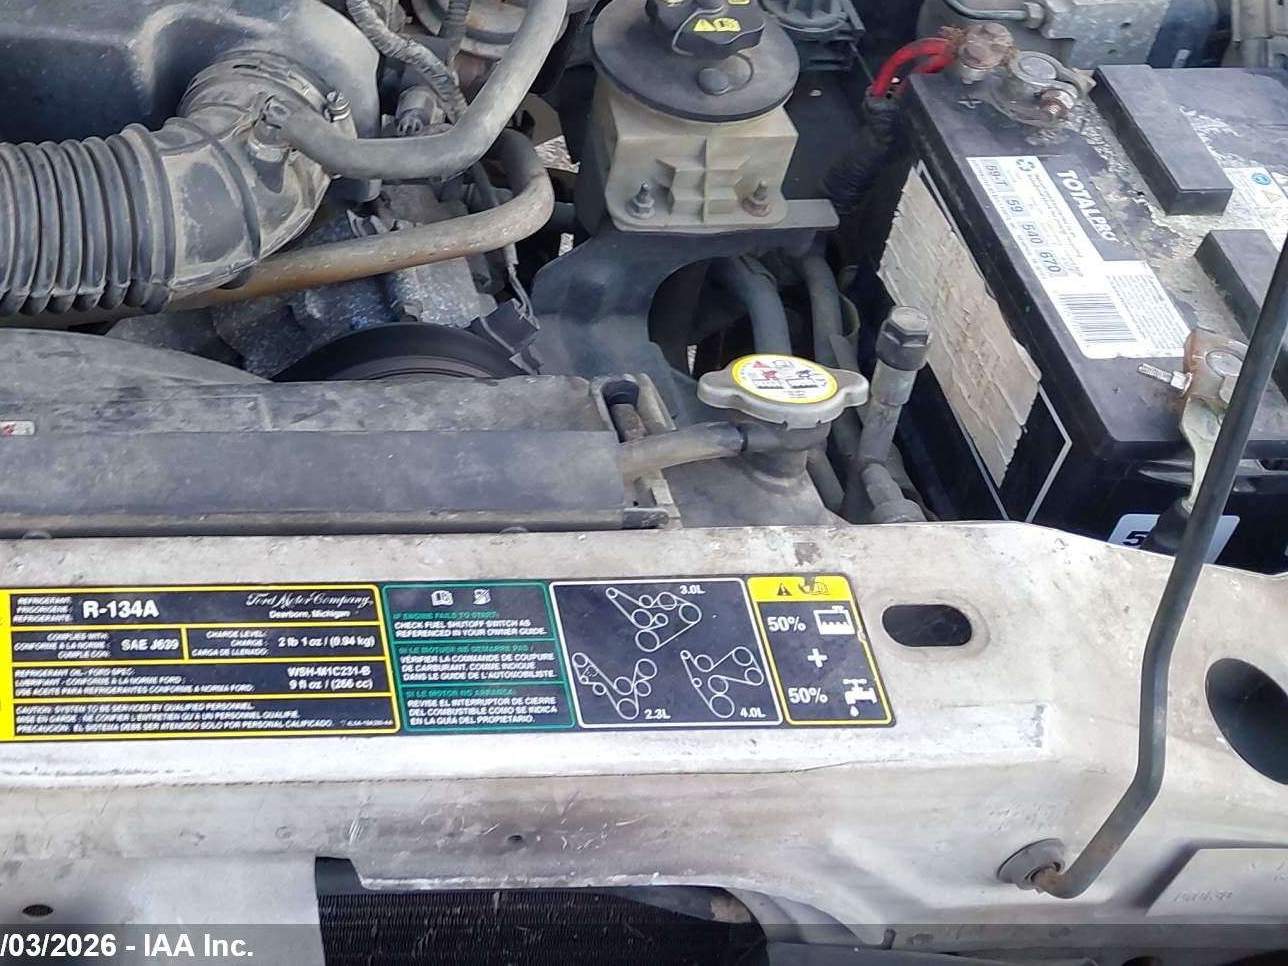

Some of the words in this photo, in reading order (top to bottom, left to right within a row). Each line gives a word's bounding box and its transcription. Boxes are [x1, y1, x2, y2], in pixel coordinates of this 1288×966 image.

[984, 164, 1009, 186] 59-T
[1008, 198, 1024, 213] 59
[1056, 170, 1120, 243] TOTALPRO
[1039, 251, 1062, 273] 670
[679, 584, 705, 595] 3.0L
[245, 592, 275, 606] Ford
[275, 591, 311, 609] Motor
[83, 600, 160, 619] R-134A
[394, 621, 424, 630] CHECK
[424, 621, 446, 629] FUEL
[447, 620, 484, 629] SHUTOFF
[485, 619, 518, 628] SWITCH
[519, 619, 531, 627] AS
[767, 616, 807, 632] 50%
[452, 629, 461, 637] IN
[461, 628, 485, 637] YOUR
[486, 628, 518, 637] OWNER
[121, 639, 148, 651] SAE
[278, 637, 286, 647] 2
[288, 637, 299, 647] lb
[301, 637, 308, 647] 1
[309, 638, 323, 647] oz
[357, 635, 375, 648] kg)
[439, 655, 450, 663] LA
[501, 653, 513, 662] DE
[513, 652, 555, 662] COUPURE
[401, 664, 414, 673] DE
[403, 672, 427, 681] DANS
[428, 672, 439, 681] LE
[439, 672, 467, 680] GUIDE
[468, 671, 480, 680] DE
[289, 680, 296, 690] 9
[309, 680, 323, 689] oz
[355, 678, 373, 690] cc)
[788, 687, 828, 704] 50%
[407, 699, 438, 708] REVISE
[439, 699, 450, 707] EL
[451, 698, 510, 707] INTERRUPTOR
[511, 698, 523, 706] DE
[524, 697, 557, 706] CIERRE
[408, 708, 426, 717] DEL
[427, 707, 487, 716] COMBUSTIBLE
[488, 706, 515, 715] COMO
[516, 706, 528, 714] SE
[528, 705, 558, 714] INDICA
[644, 709, 671, 720] 2.3L
[740, 707, 766, 718] 4.0L
[410, 717, 423, 726] EN
[423, 717, 436, 725] LA
[458, 715, 476, 724] DEL
